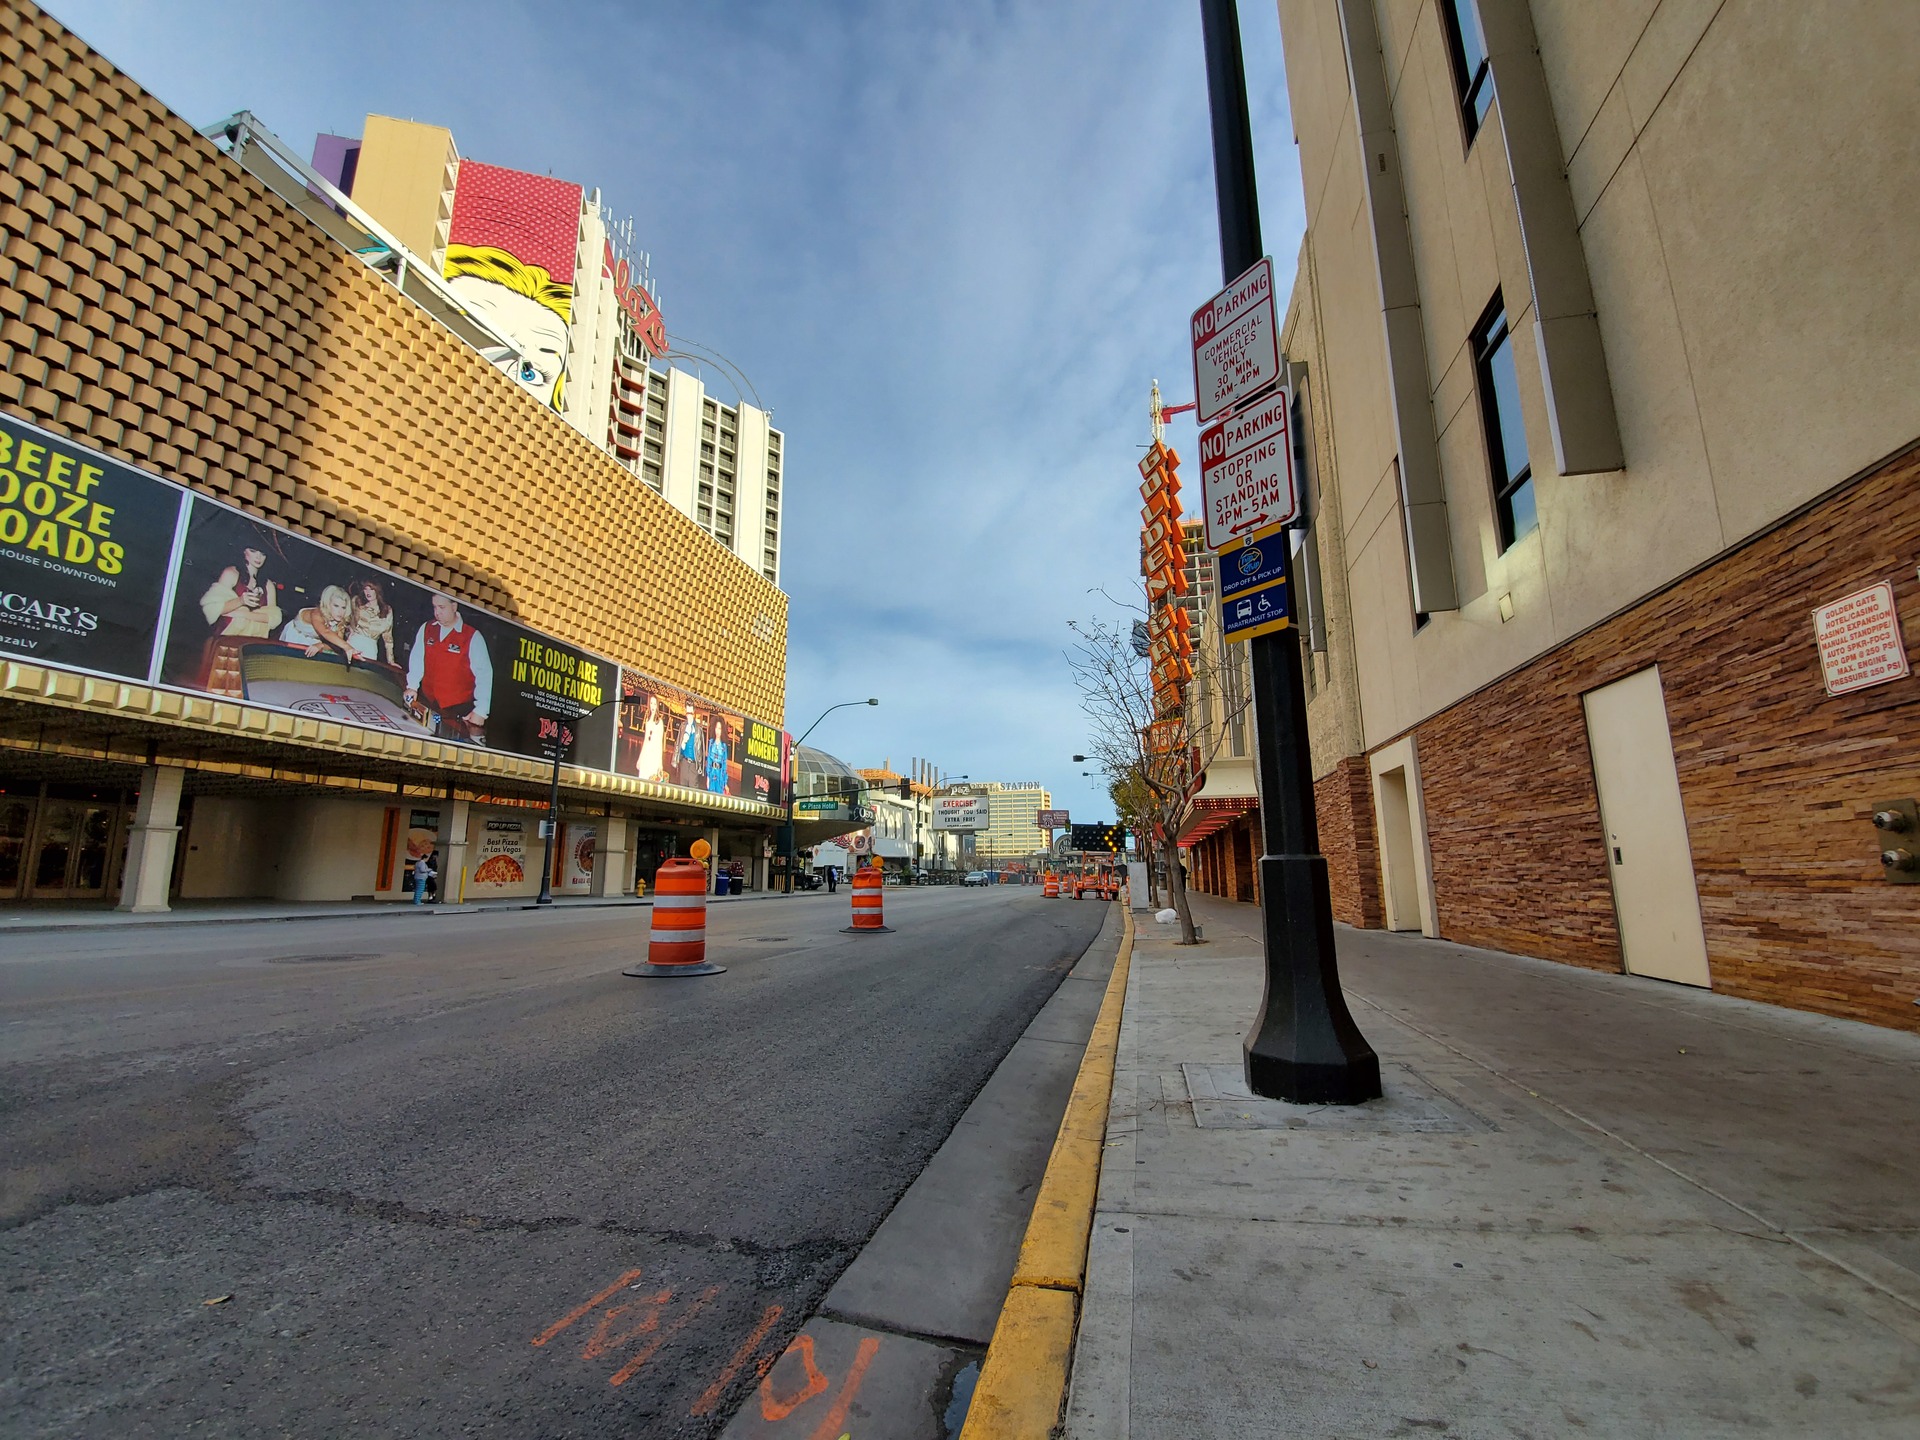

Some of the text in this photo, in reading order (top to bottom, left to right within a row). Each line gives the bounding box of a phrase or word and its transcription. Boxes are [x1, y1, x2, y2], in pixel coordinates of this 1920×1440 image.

[601, 238, 669, 360] laza
[1194, 274, 1267, 341] NO PARKING
[1205, 315, 1262, 360] COMMERCIAL
[1213, 331, 1256, 366] VEHICLES
[1217, 359, 1255, 388] 30 MIN.
[1223, 349, 1246, 371] ONLY
[1201, 405, 1282, 463] NO PARKING
[0, 428, 104, 497] BEEF
[1213, 442, 1276, 484] STOPPING
[1236, 470, 1253, 488] OR
[1216, 473, 1278, 513] STANDING
[1139, 444, 1172, 600] GOLDEN
[43, 560, 117, 588] DOWNTOWN
[1223, 566, 1282, 592] DROP OFF & PICK UP
[0, 591, 98, 631] CAR'S
[1227, 608, 1284, 630] PARATRANSIT STOP
[1825, 593, 1876, 619] GOLDEN GATE
[1825, 603, 1879, 629] HOTEL/CASINO
[44, 622, 88, 637] BROADS
[1819, 610, 1891, 641] CASINO EXPANSION
[1821, 620, 1891, 651] MANUAL STANDPIPE/
[1826, 661, 1839, 669] 500
[1840, 653, 1857, 665] GPM
[1865, 645, 1880, 656] 250
[1882, 640, 1896, 651] PSI
[1827, 632, 1891, 659] AUTO SPKR-FDC3
[520, 638, 598, 684] THE ODDS ARE
[1830, 661, 1901, 688] PRESSURE 250 PSI
[1837, 654, 1888, 676] MAX. ENGINE
[512, 660, 602, 706] IN YOUR FAVOR!
[520, 691, 534, 700] OVER
[536, 702, 561, 713] BLACKJACK
[752, 723, 776, 743] GOLDEN
[748, 738, 779, 763] MOMENTS
[1000, 781, 1040, 791] STATION
[943, 800, 977, 808] EXERCISE?
[487, 838, 518, 846] Best Pizza
[503, 846, 521, 854] Vegas
